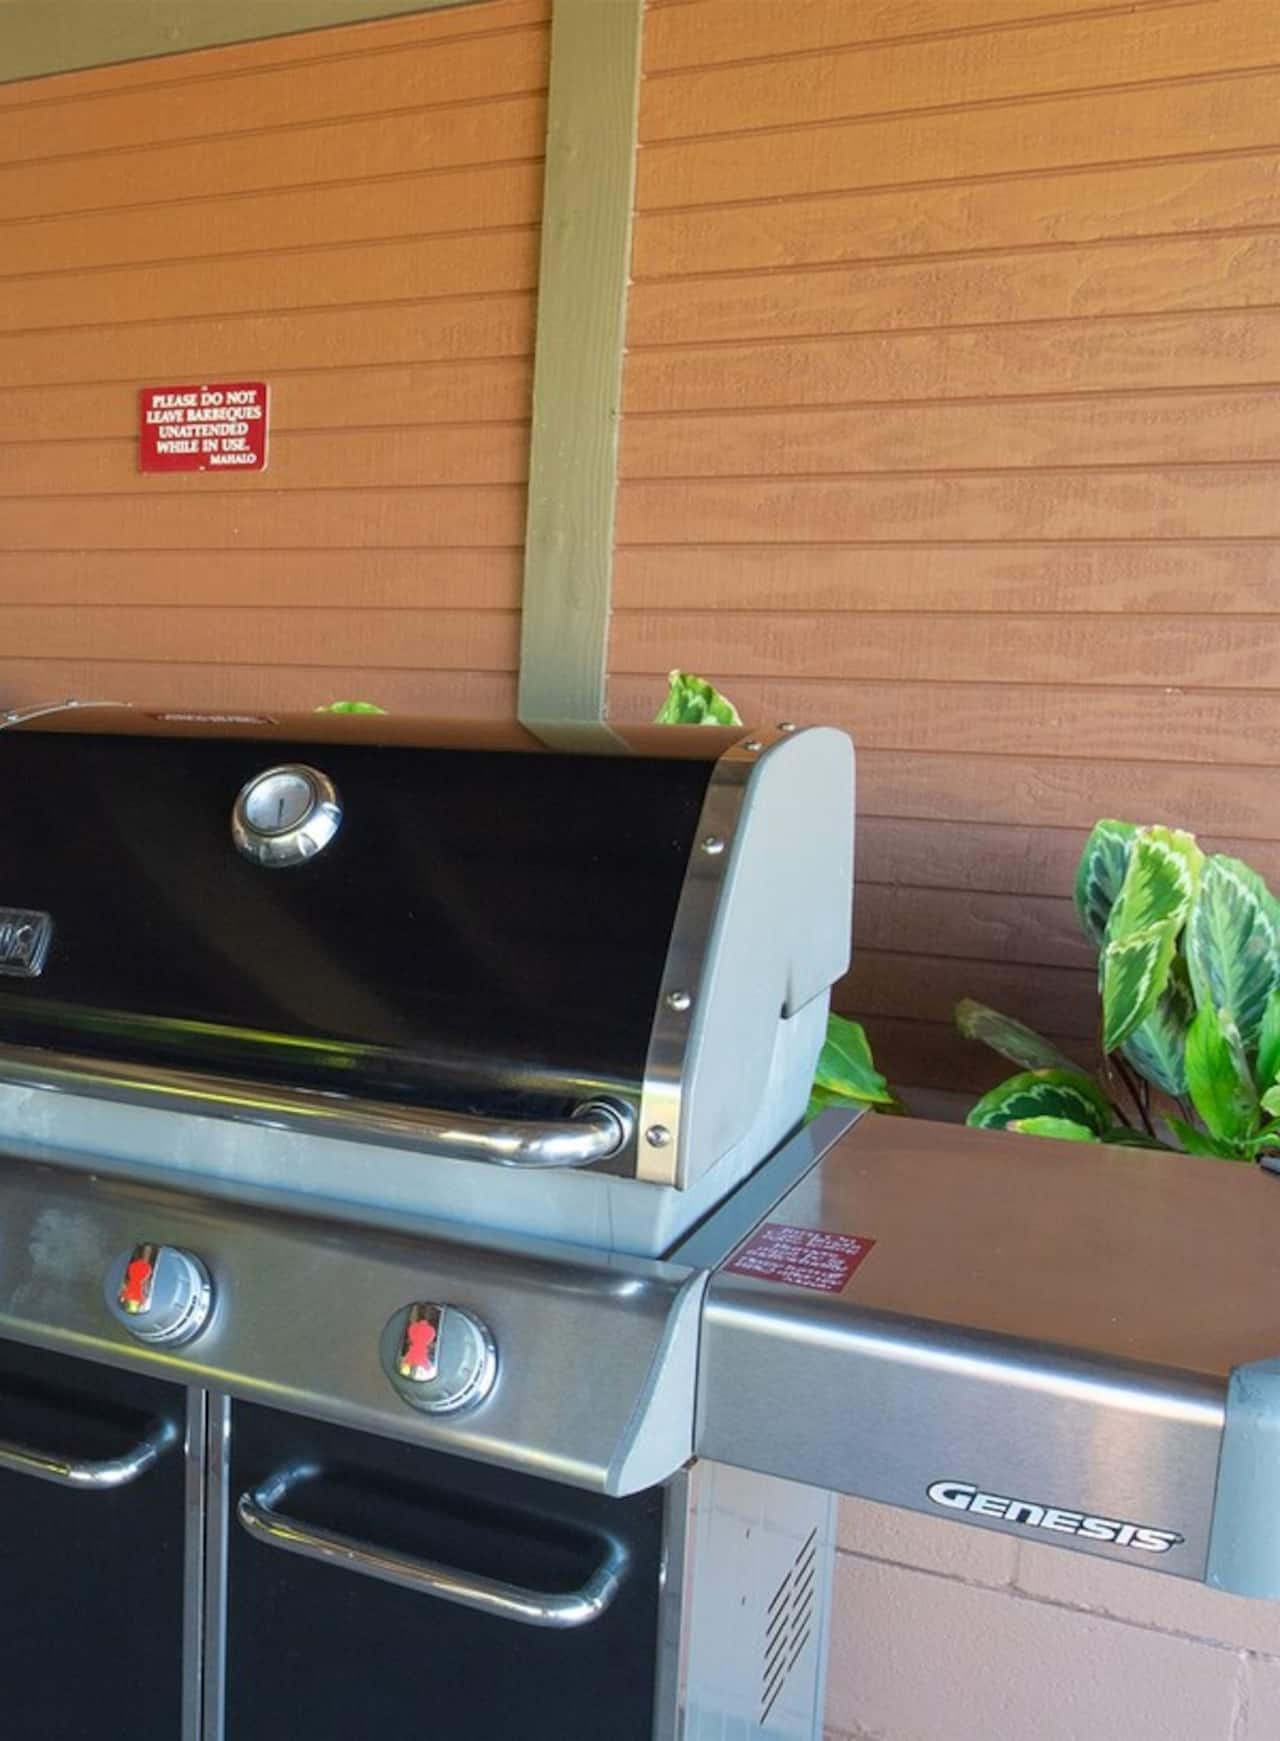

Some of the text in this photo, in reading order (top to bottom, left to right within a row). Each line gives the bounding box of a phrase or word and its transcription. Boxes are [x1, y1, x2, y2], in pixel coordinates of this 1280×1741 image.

[152, 390, 257, 408] PLEASE DO NOT
[146, 406, 262, 424] LEAVE BARBEQUES
[158, 422, 249, 439] UNATTENDED
[156, 438, 251, 454] WHILE IN USE.
[210, 453, 257, 465] MAHALO
[926, 1480, 1176, 1553] GENESIS
